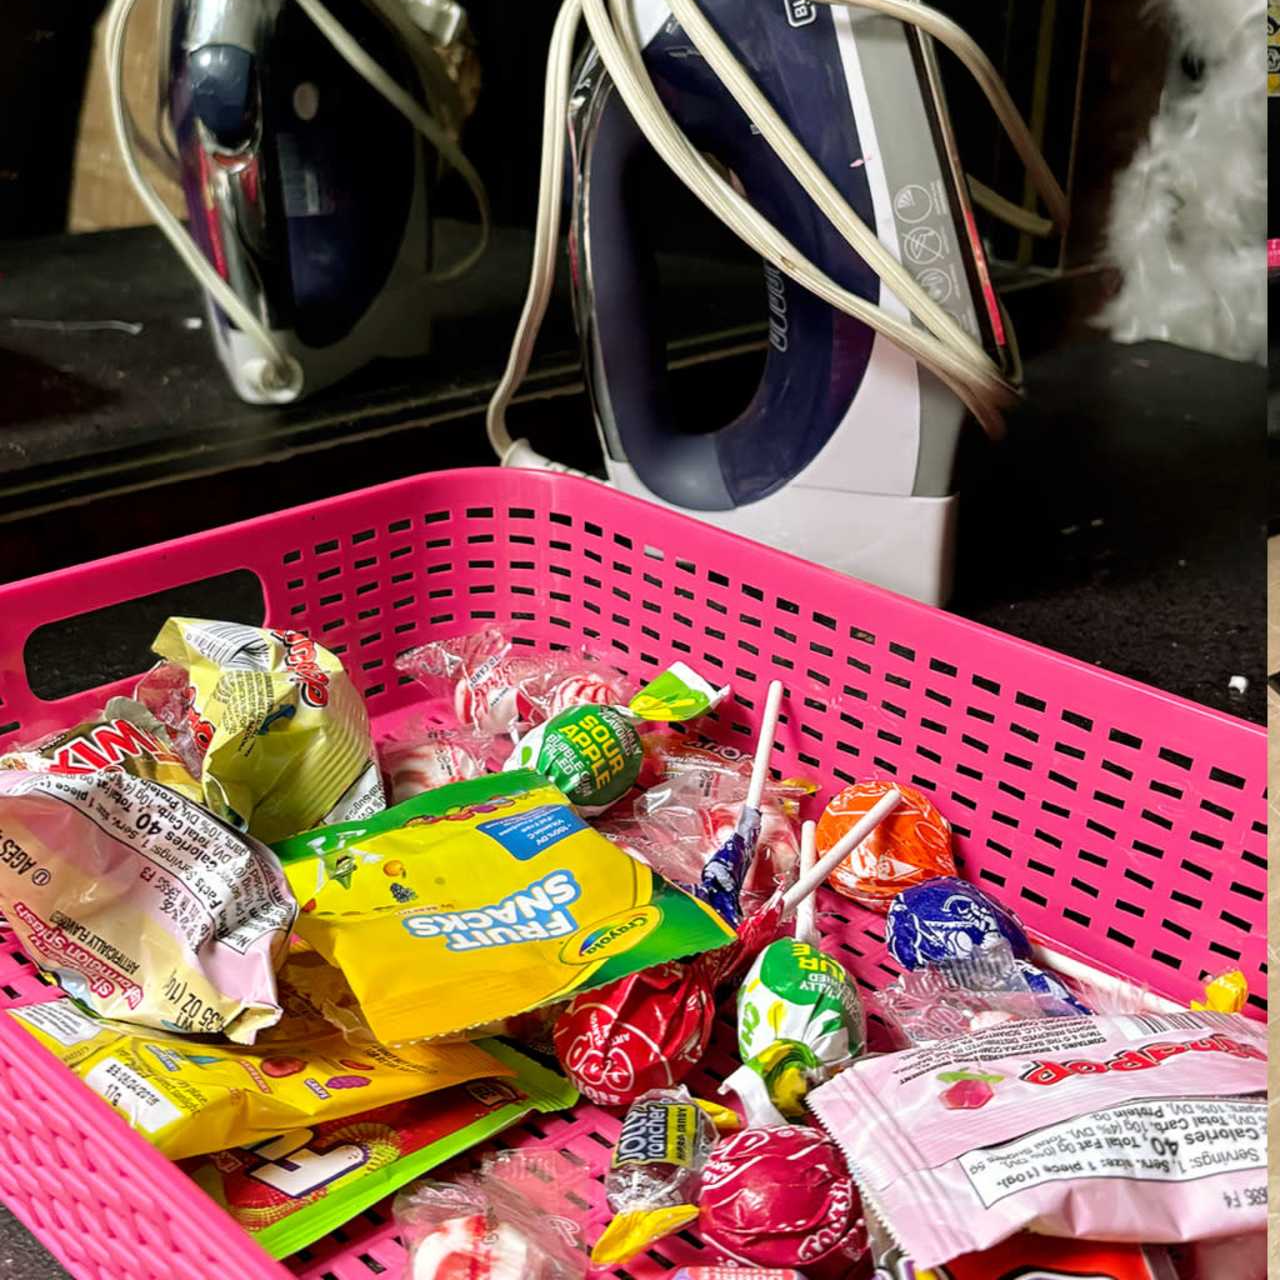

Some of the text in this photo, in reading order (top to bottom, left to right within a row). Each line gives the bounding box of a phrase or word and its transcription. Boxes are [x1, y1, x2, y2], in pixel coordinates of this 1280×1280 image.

[560, 725, 610, 788] APPLE
[580, 716, 624, 775] SOUR
[164, 830, 218, 872] Calories
[407, 873, 578, 936] SNACKS
[451, 911, 574, 950] FRUIT
[583, 915, 648, 955] Crayola
[86, 931, 141, 974] ARTIFICIALLY
[619, 1103, 651, 1162] JOLLY
[646, 1105, 667, 1159] rancher
[1112, 1103, 1163, 1125] Protein
[1192, 1111, 1226, 1130] Total
[1077, 1137, 1101, 1151] Fat
[1105, 1133, 1138, 1151] Total
[1183, 1121, 1259, 1150] Calories
[1187, 1143, 1259, 1171] Servings:
